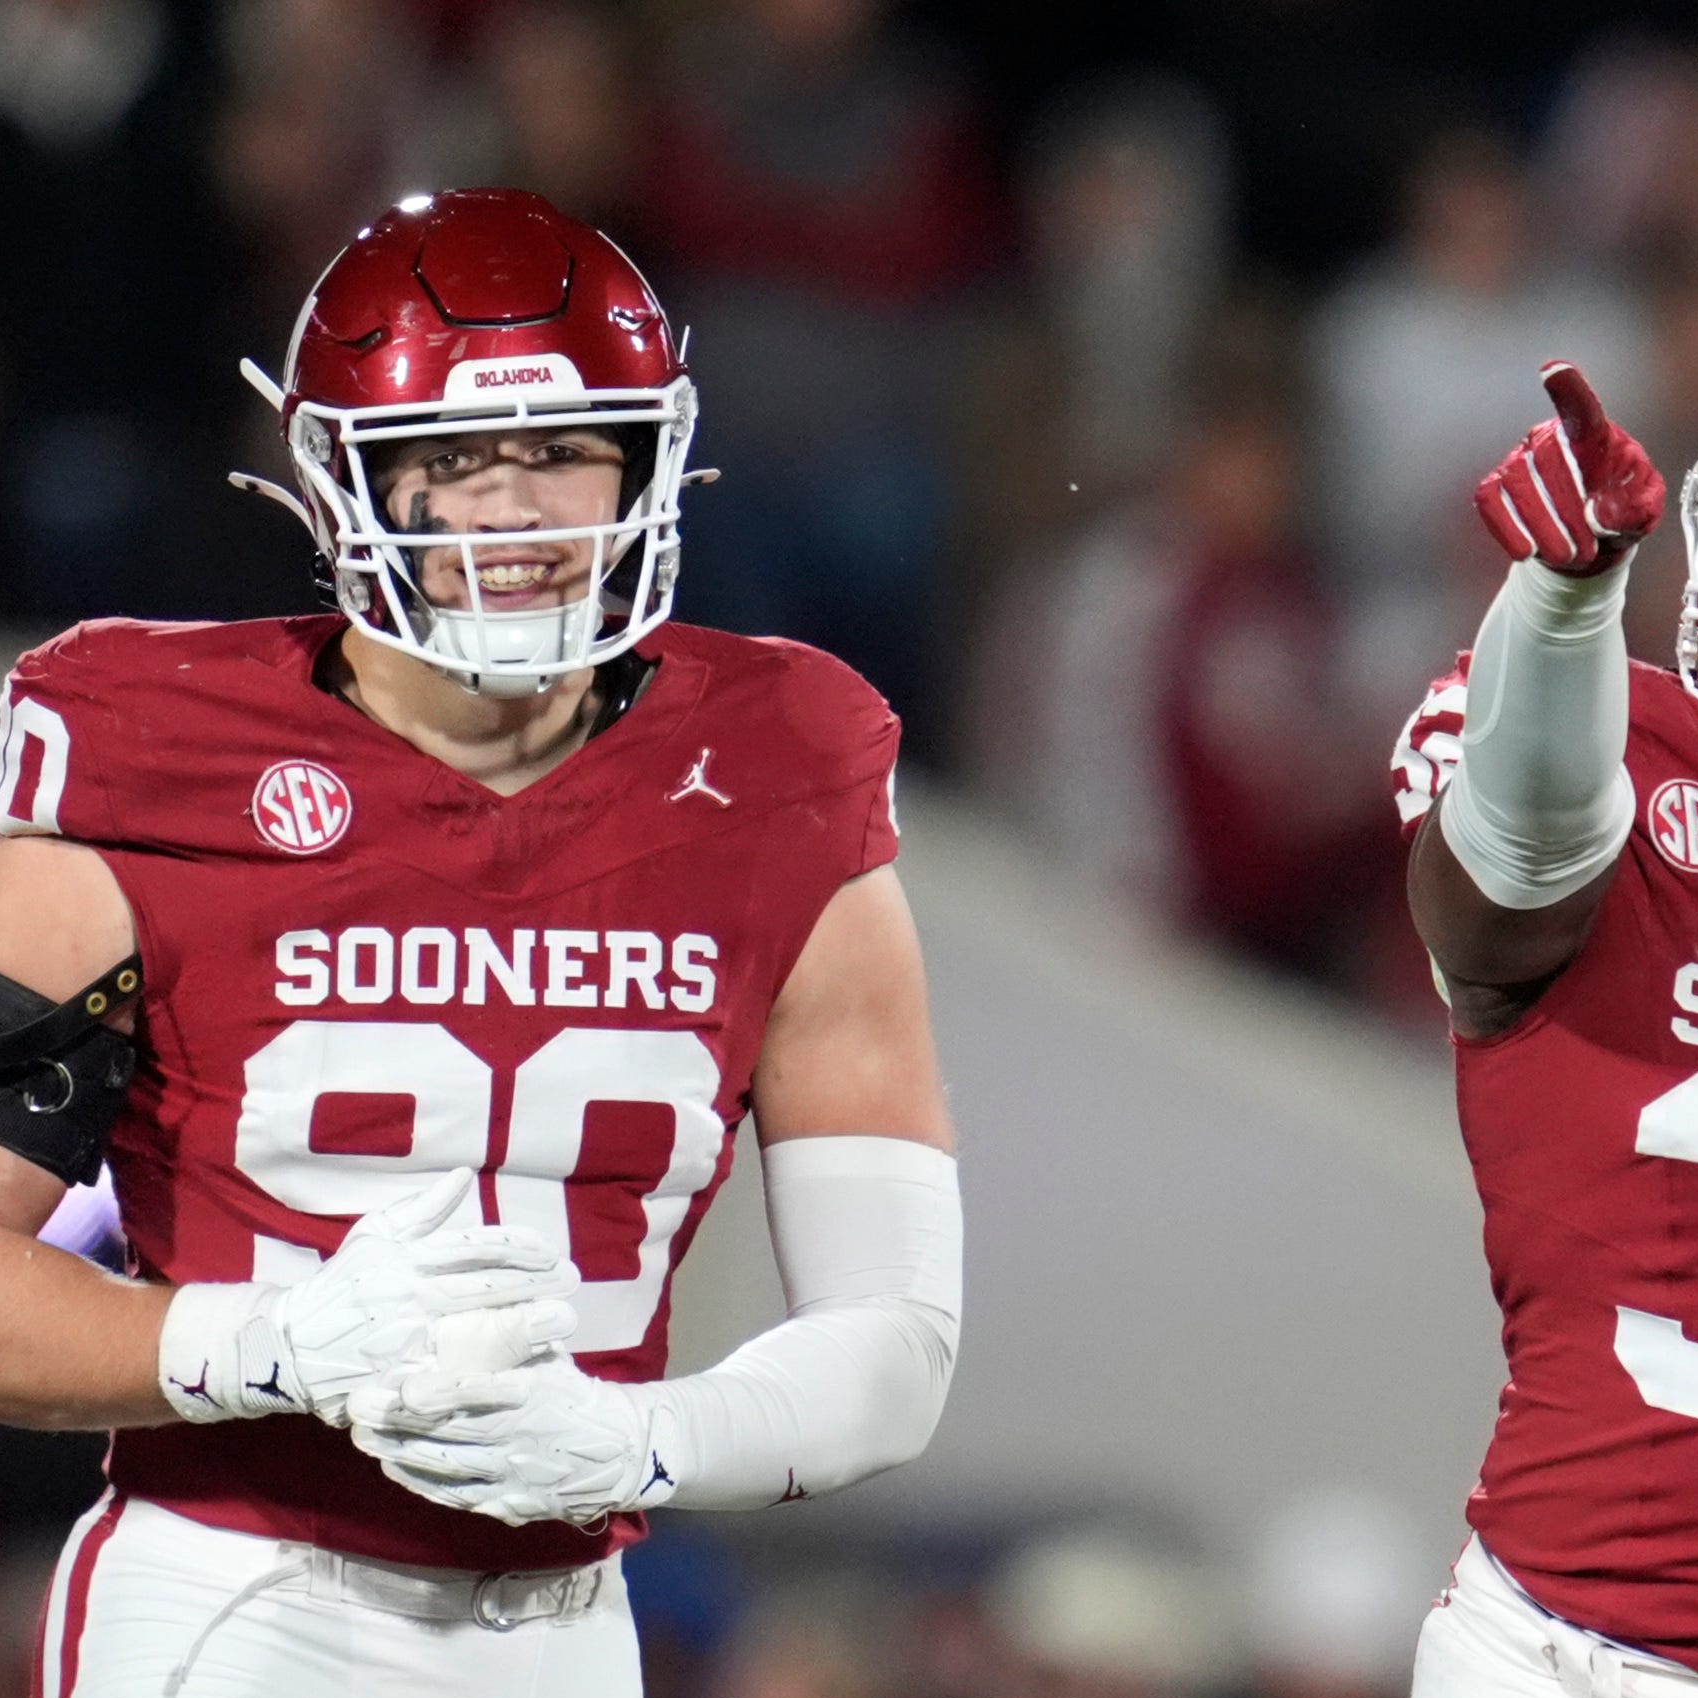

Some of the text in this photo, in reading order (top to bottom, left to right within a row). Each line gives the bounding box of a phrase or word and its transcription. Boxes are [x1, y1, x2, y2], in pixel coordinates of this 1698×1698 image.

[474, 367, 554, 388] OKLAHOMA
[260, 766, 343, 848] SEC
[275, 926, 718, 1013] SOONERS
[234, 1020, 725, 1354] 90
